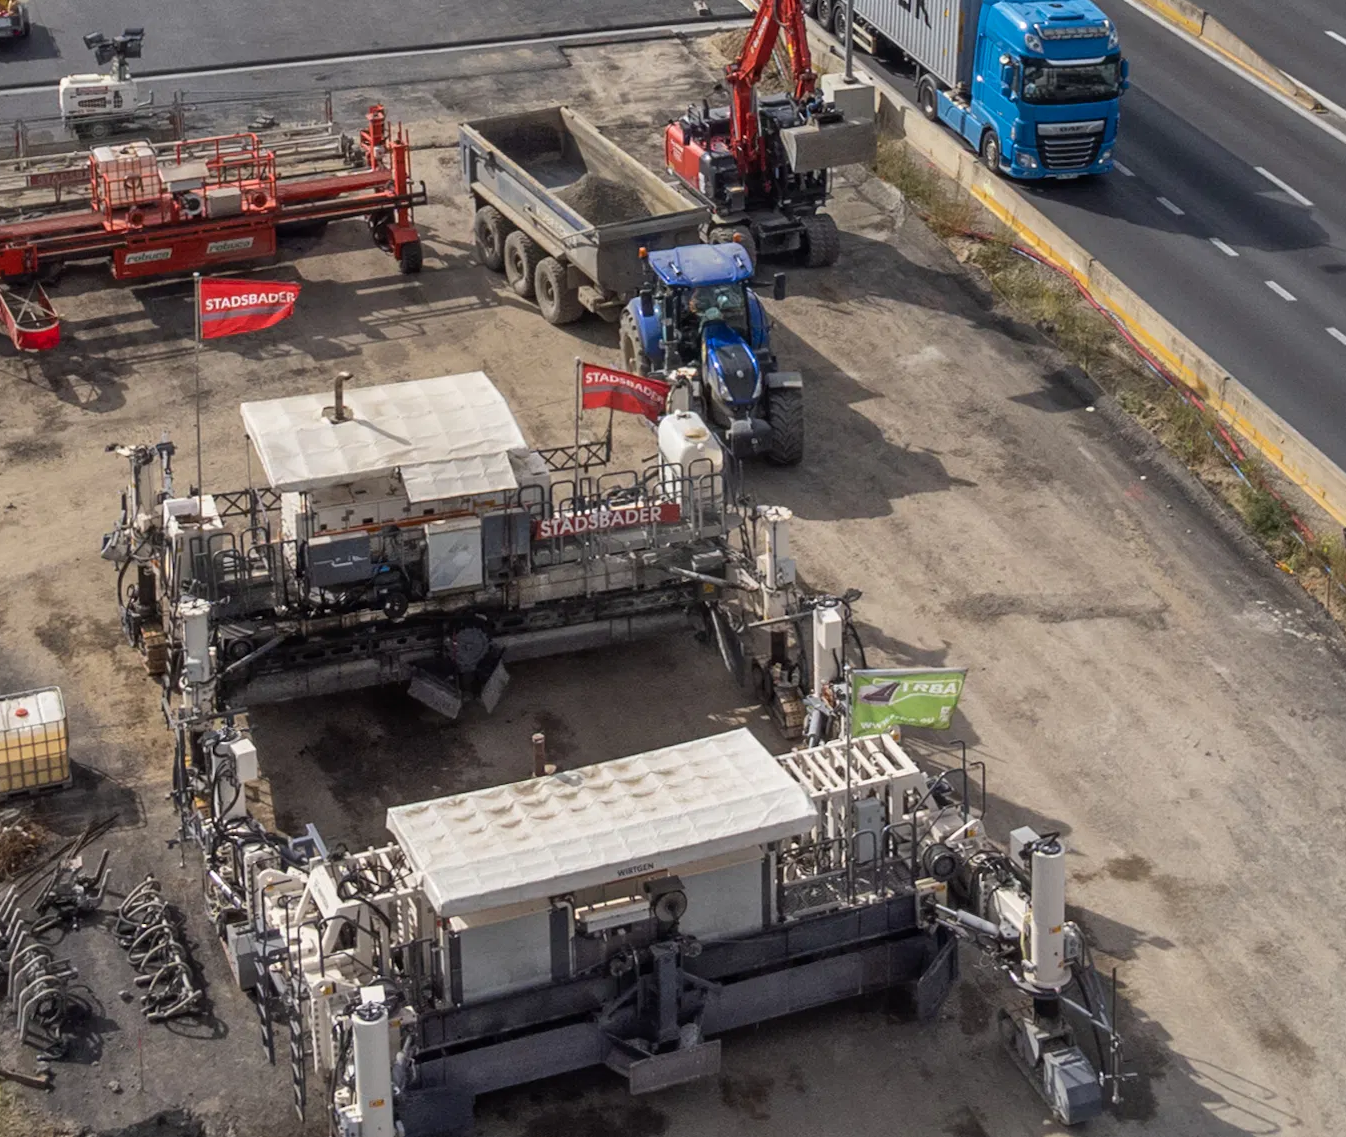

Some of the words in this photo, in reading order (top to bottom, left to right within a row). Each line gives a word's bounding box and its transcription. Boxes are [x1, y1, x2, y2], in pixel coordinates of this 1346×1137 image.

[205, 292, 295, 311] STADSBADER
[584, 372, 665, 404] STADSBADER
[540, 507, 662, 537] STADSBADER
[617, 863, 654, 876] WIRTGEN
